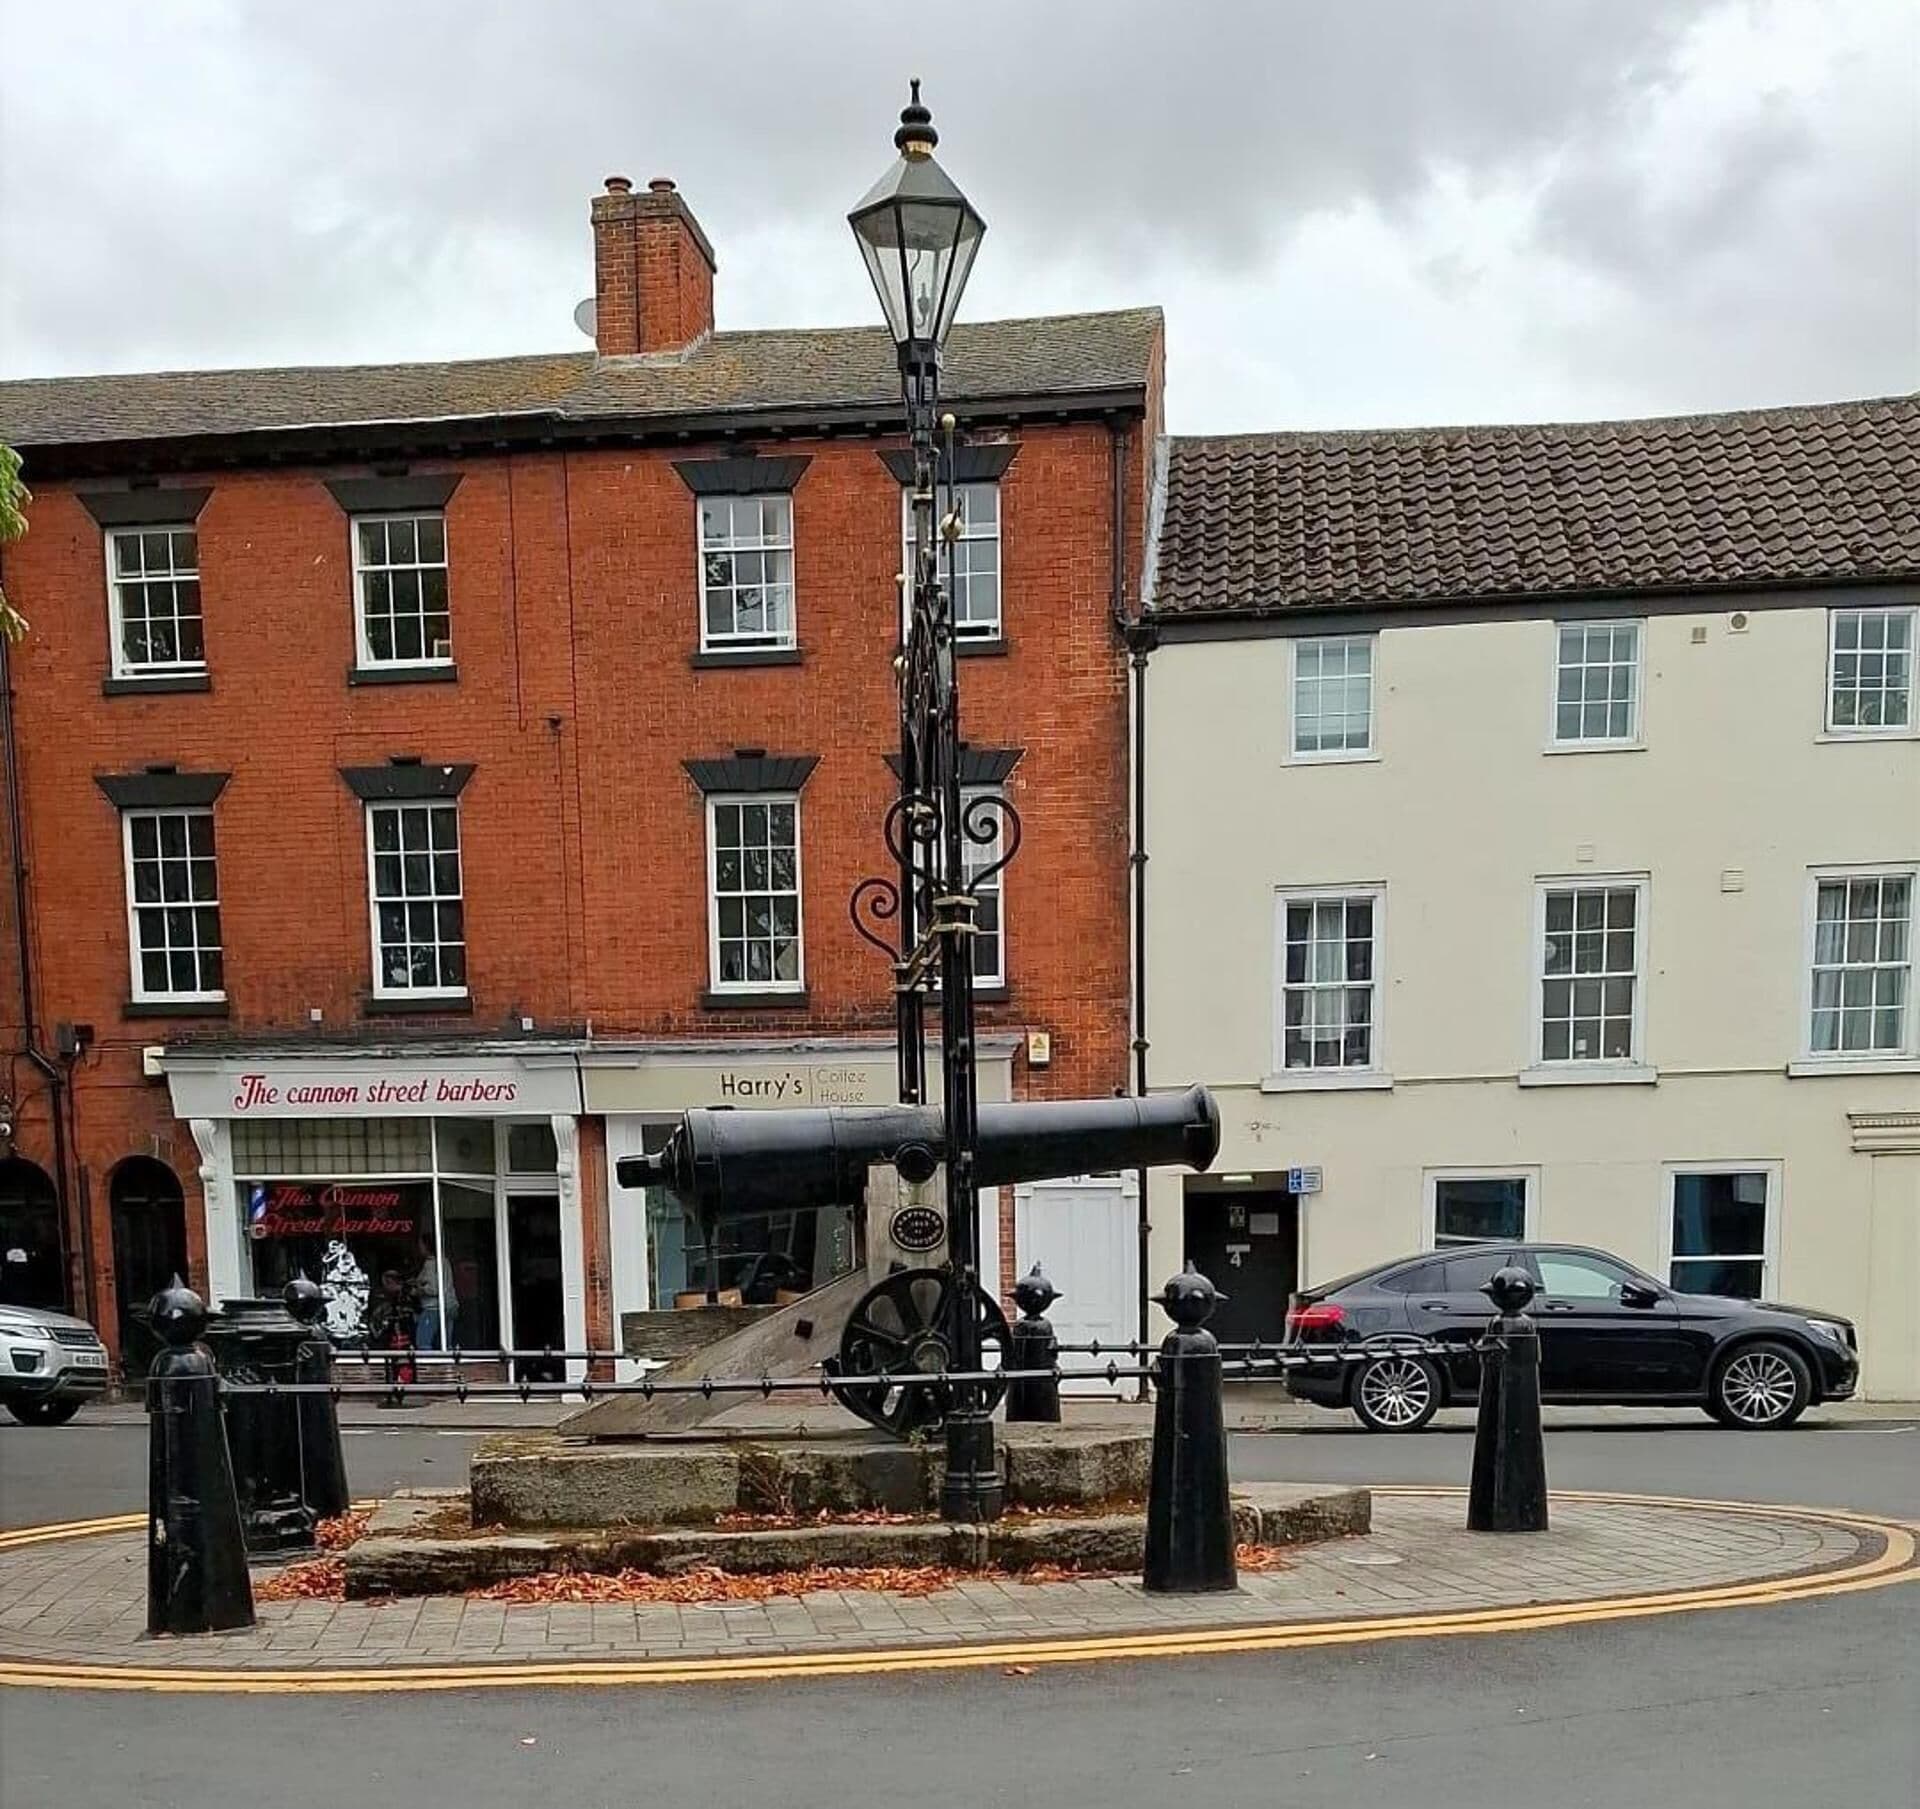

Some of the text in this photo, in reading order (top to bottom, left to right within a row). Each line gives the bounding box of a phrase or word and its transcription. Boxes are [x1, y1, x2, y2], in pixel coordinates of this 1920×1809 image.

[721, 1073, 802, 1099] Harry's
[816, 1069, 866, 1084] Coffee
[235, 1075, 516, 1110] The cannon street barbers
[820, 1089, 865, 1103] House
[269, 1186, 400, 1211] The Cannon
